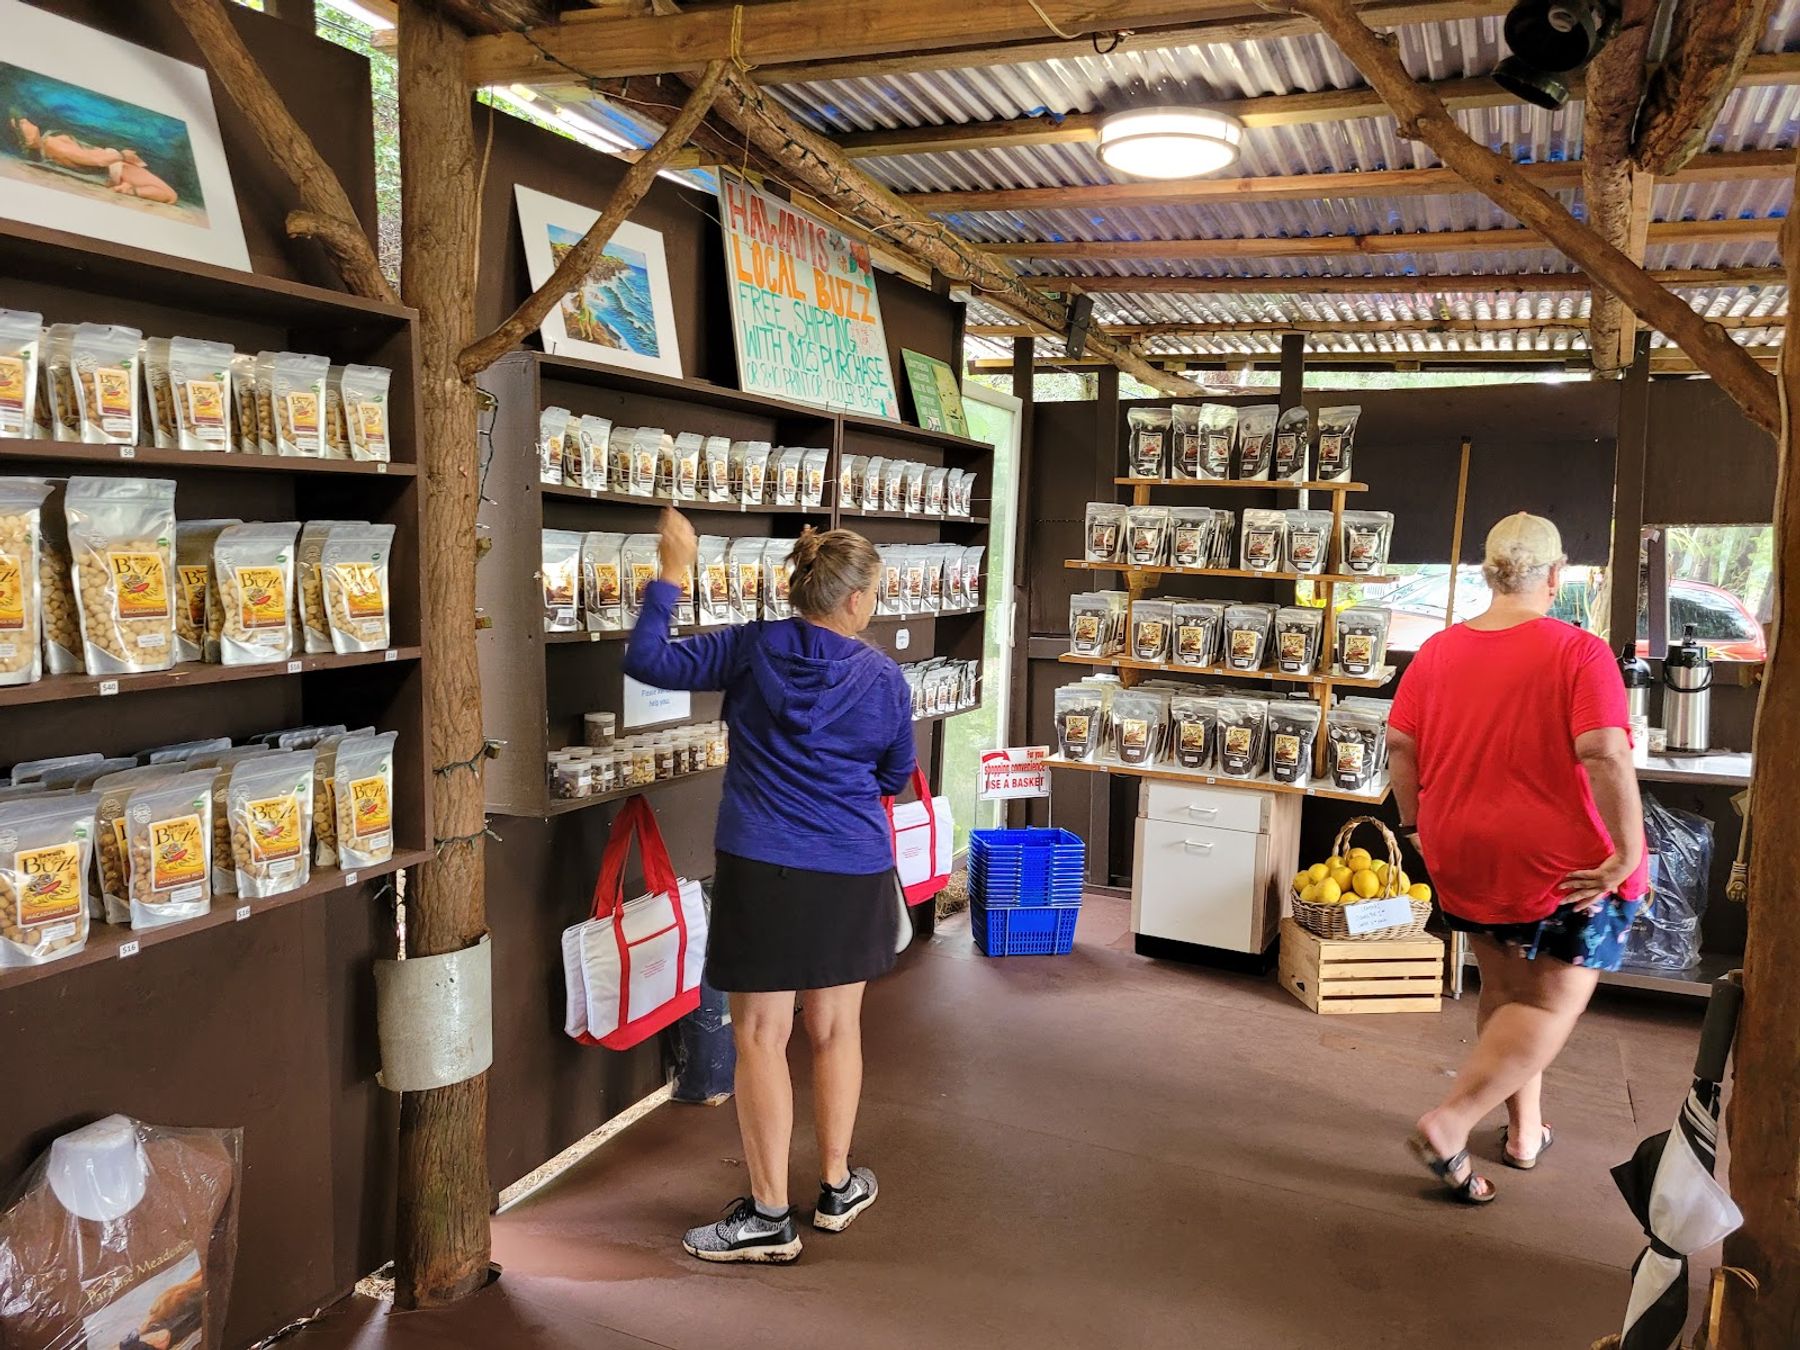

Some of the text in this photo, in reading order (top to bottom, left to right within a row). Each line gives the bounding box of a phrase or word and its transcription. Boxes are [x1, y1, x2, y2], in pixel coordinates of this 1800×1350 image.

[732, 233, 877, 325] LOCAL BUZZ
[739, 283, 857, 353] FREE SHIPPING
[743, 319, 785, 366] WITH
[820, 344, 888, 388] PURCHASE
[747, 361, 760, 385] OR
[783, 367, 810, 397] PRINT
[102, 683, 116, 692] $40
[1004, 779, 1009, 789] A
[1012, 777, 1045, 788] BASKET
[238, 909, 250, 918] $16
[122, 944, 137, 955] $16
